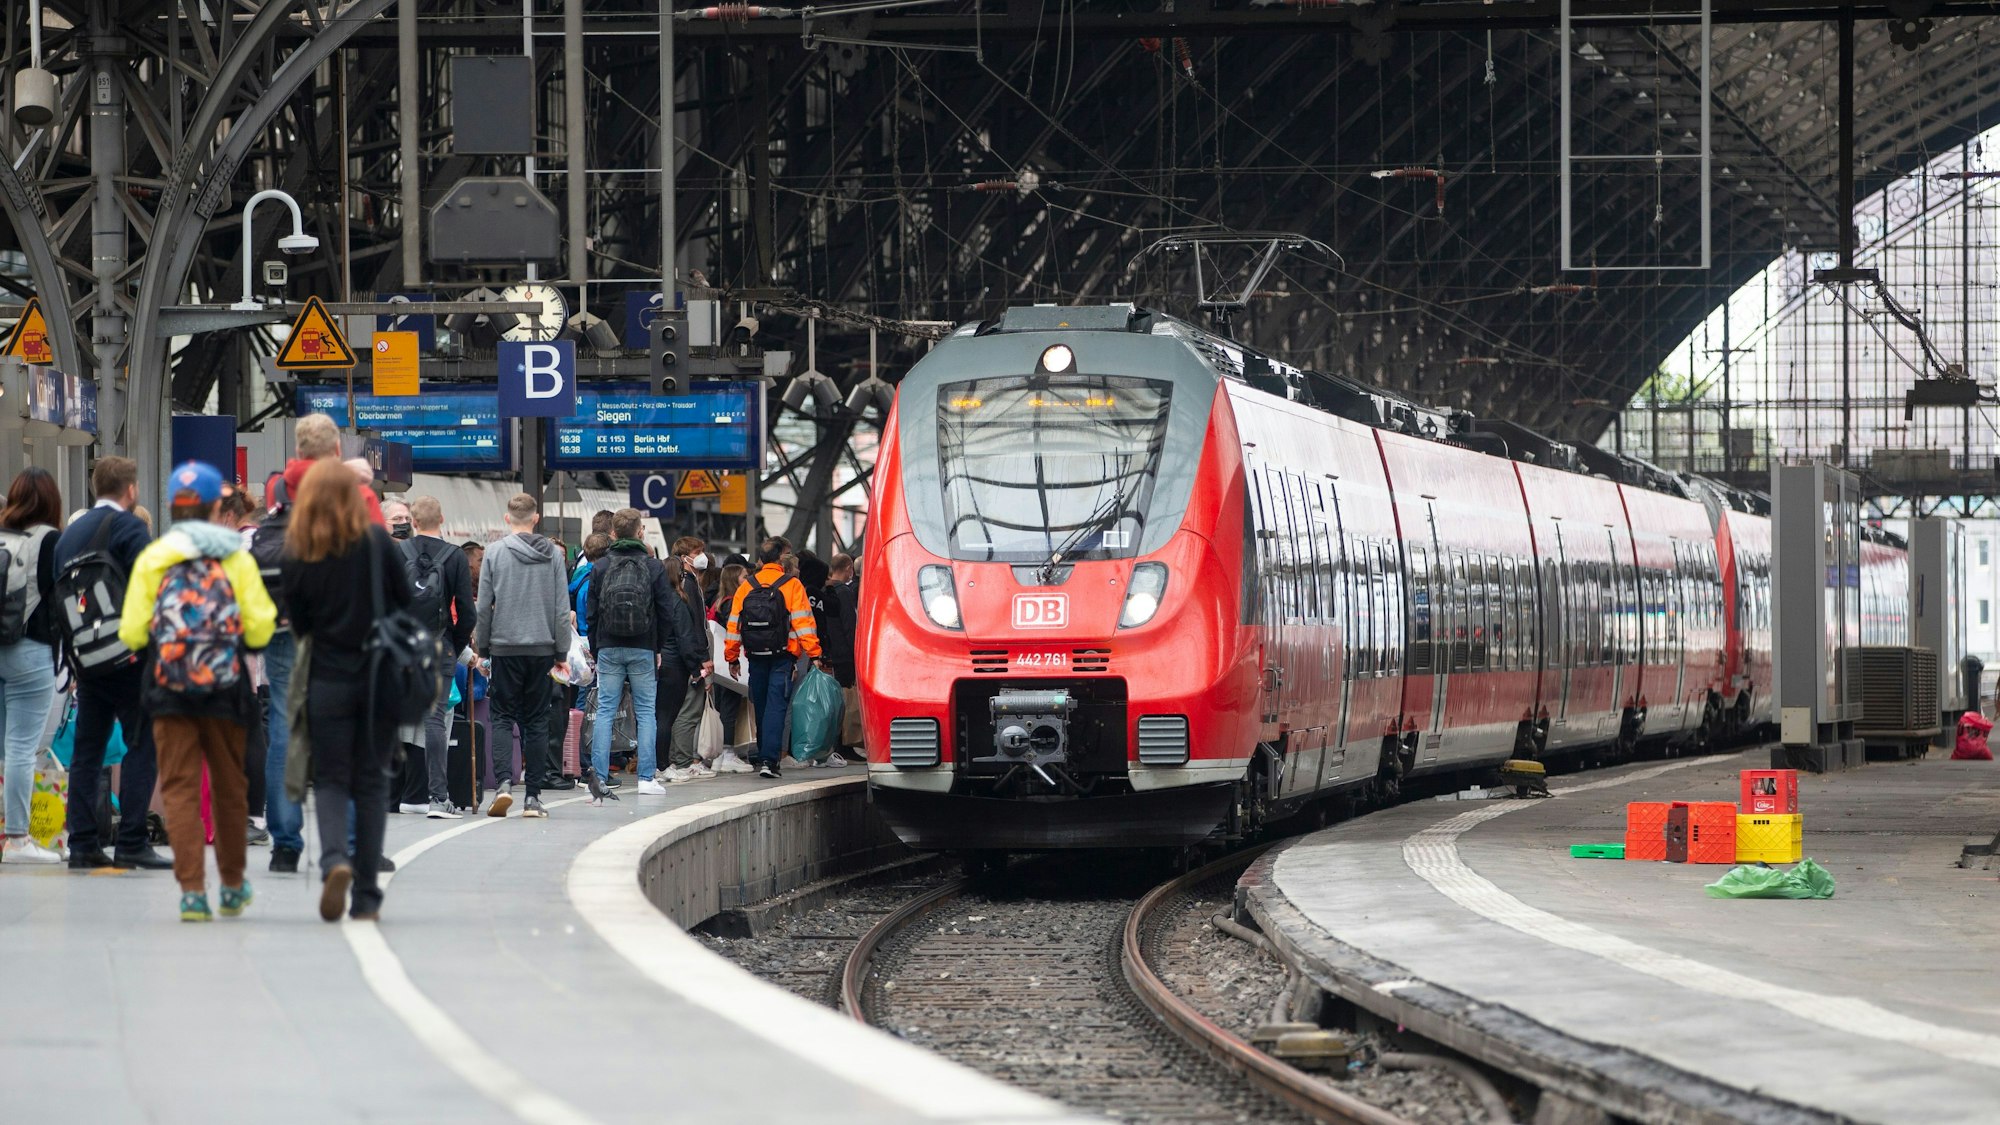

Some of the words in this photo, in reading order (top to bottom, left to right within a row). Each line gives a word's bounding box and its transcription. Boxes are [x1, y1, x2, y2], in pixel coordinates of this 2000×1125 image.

[524, 344, 564, 399] B
[358, 412, 403, 420] Oberbarmen
[597, 411, 631, 424] Siegen
[560, 435, 581, 443] 16:38
[597, 435, 607, 443] ICE
[610, 435, 626, 443] 1153
[634, 435, 655, 443] Berlin
[657, 434, 670, 443] Hbf
[560, 446, 581, 454] 16:38
[634, 445, 655, 453] Berlin
[643, 474, 668, 509] C
[1019, 599, 1062, 623] DB
[1016, 653, 1042, 666] 442
[1044, 653, 1067, 666] 761
